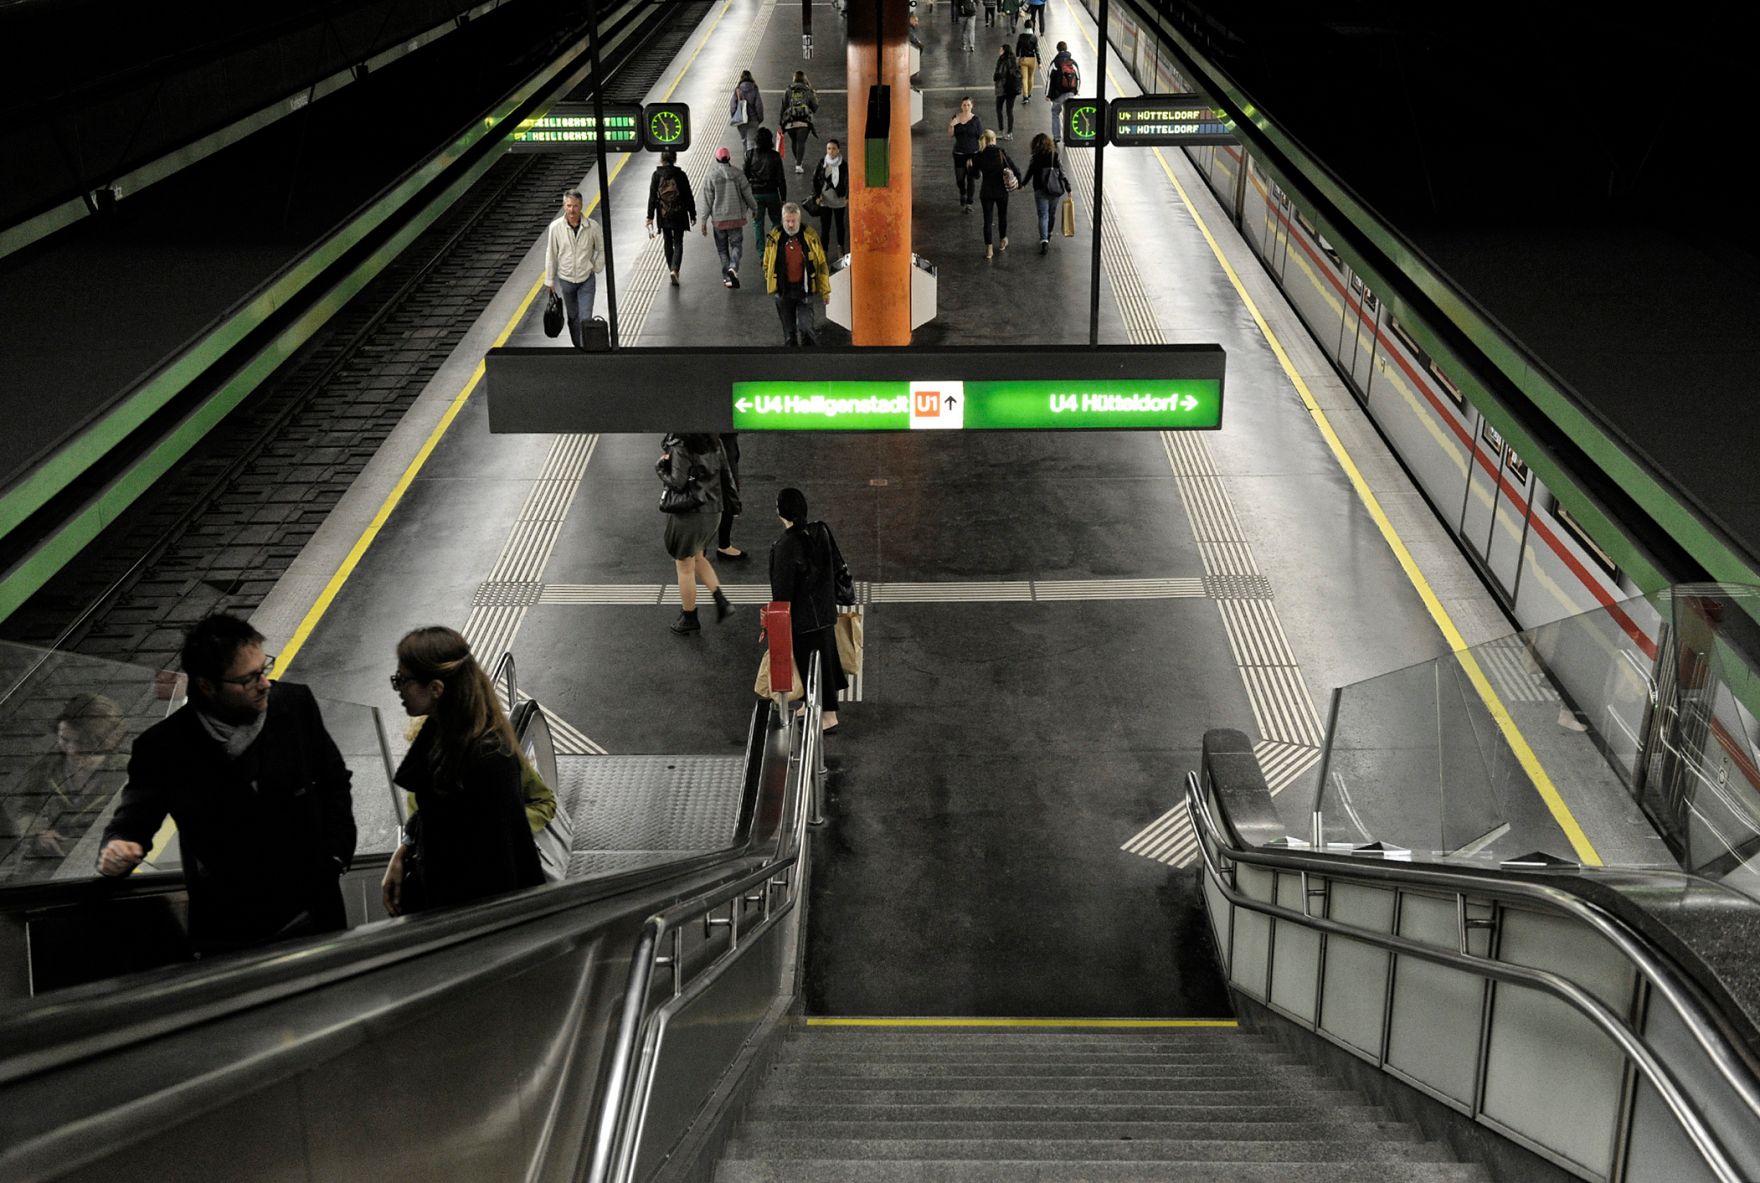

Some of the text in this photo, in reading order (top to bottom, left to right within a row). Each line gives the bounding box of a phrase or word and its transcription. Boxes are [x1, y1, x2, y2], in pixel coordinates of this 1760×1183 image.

[1118, 112, 1131, 120] U4
[1118, 125, 1131, 134] U4
[755, 395, 909, 417] U4 Heiligenstadt
[917, 395, 938, 412] U1
[1050, 393, 1178, 412] U4 Hütteldorf
